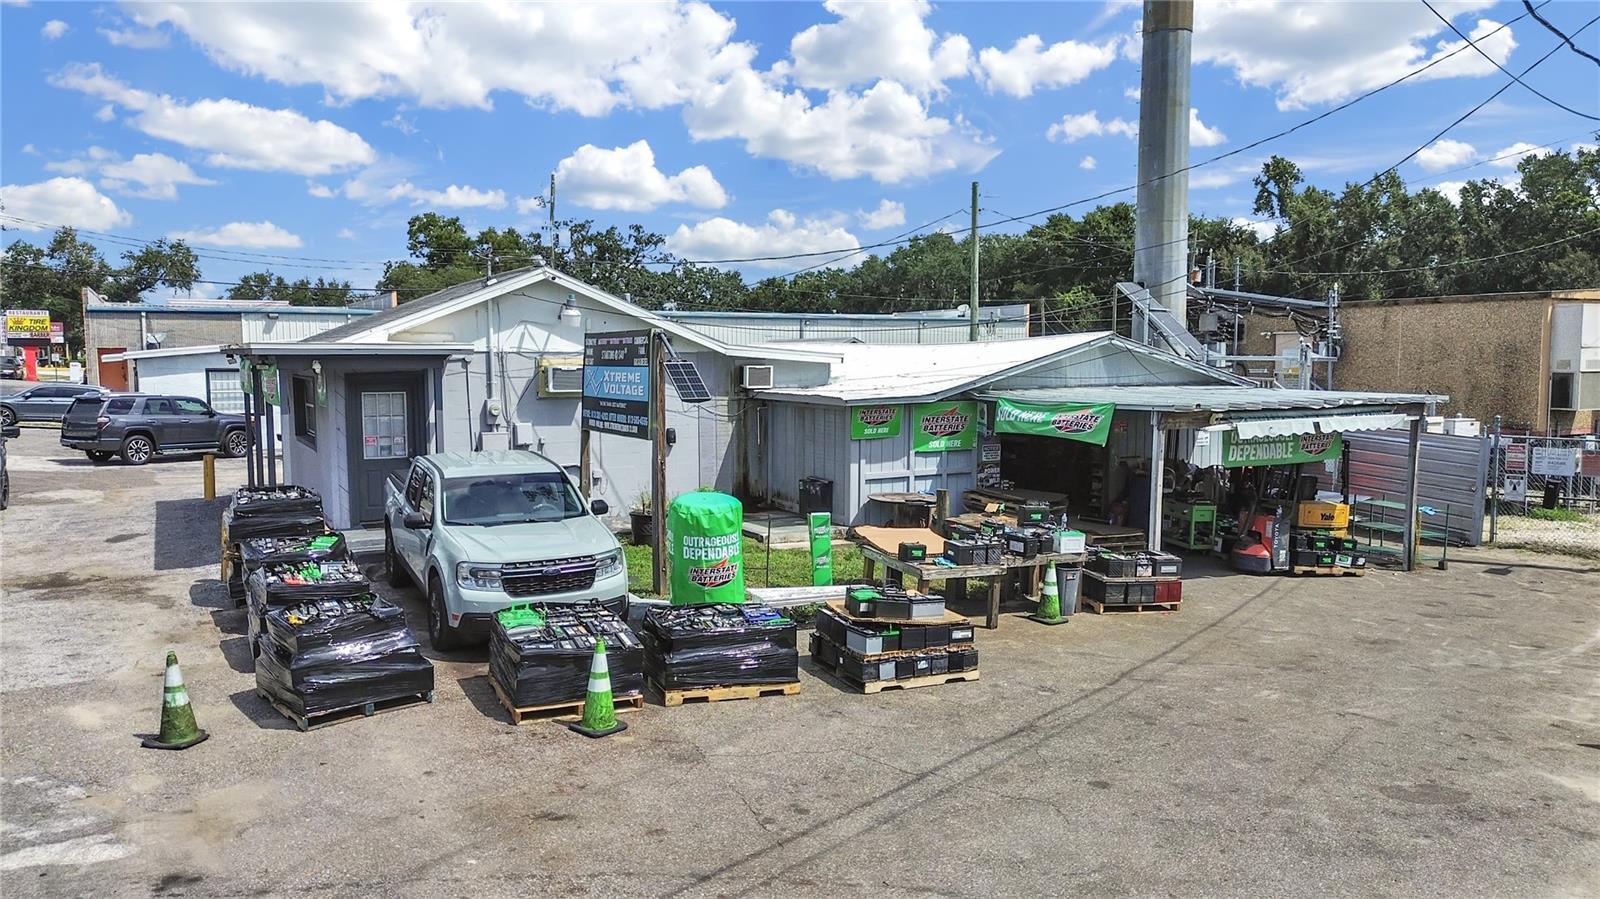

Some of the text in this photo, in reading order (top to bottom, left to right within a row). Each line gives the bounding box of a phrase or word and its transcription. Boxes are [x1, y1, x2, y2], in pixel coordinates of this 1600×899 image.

[604, 370, 641, 383] XTREME
[604, 383, 644, 396] VOLTAGE
[997, 406, 1021, 421] SOLD
[922, 415, 969, 424] INTERSTATE
[1052, 419, 1094, 430] BATTERIES
[923, 423, 965, 432] BATTERIES
[928, 440, 945, 448] SOLD
[1228, 442, 1294, 461] DEPENDABLE
[1320, 512, 1335, 521] Yale
[683, 531, 739, 547] OUTRAGEOUSL
[691, 573, 736, 582] BATTERIES
